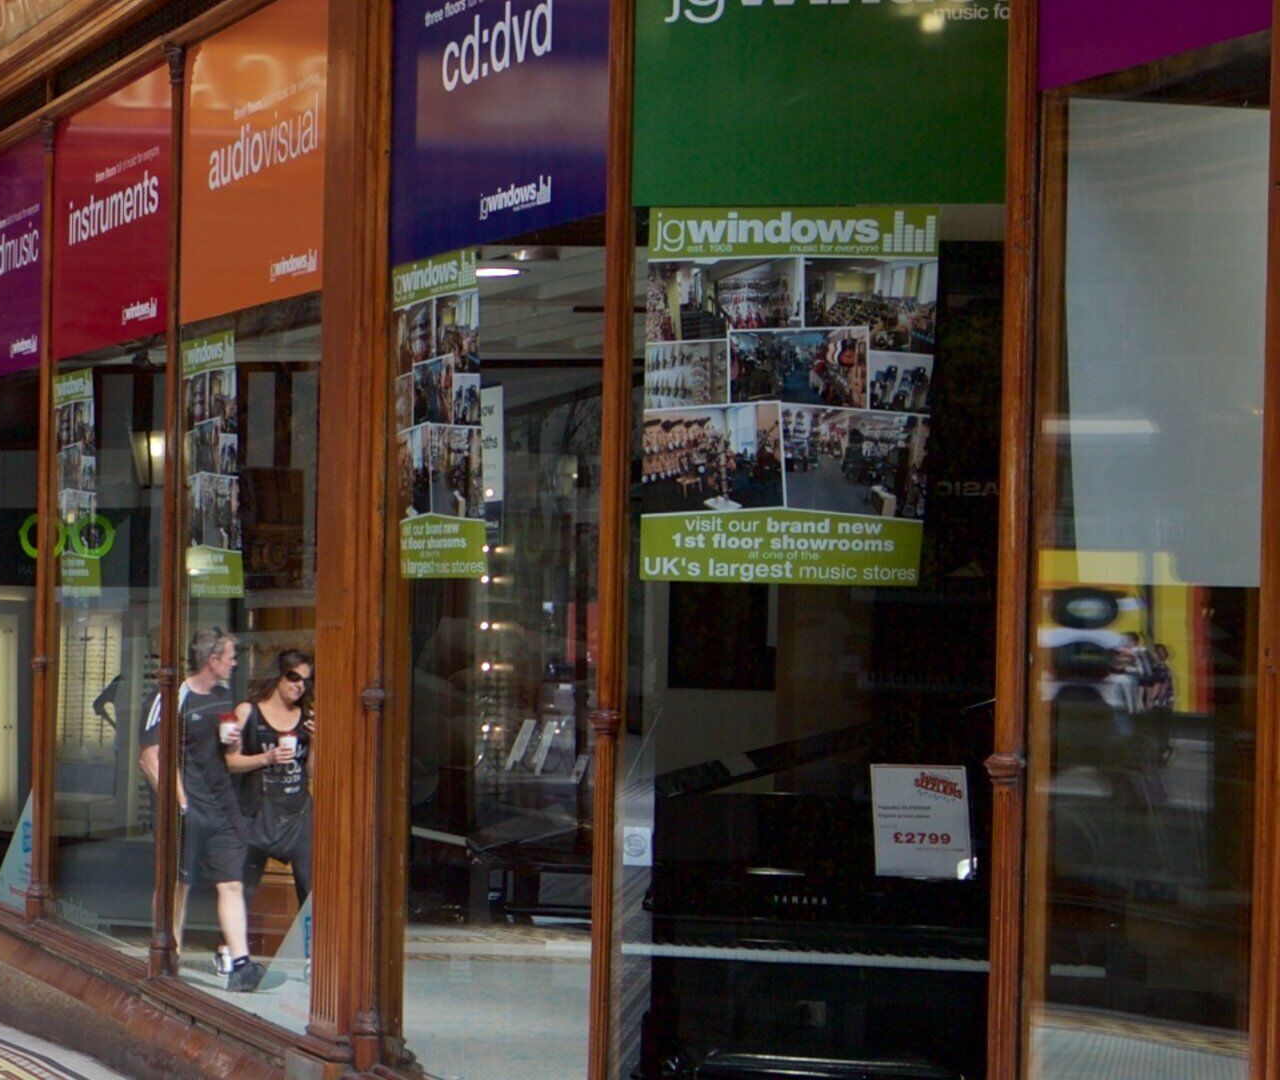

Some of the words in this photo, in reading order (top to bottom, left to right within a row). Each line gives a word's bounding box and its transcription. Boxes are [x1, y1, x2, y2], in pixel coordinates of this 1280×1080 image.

[425, 8, 443, 27] three
[934, 4, 989, 20] music
[993, 4, 1011, 20] fo
[208, 92, 319, 190] audiovisual
[68, 169, 160, 246] instruments
[479, 181, 537, 221] jgwindows
[653, 211, 880, 252] jgwindows
[790, 244, 818, 253] music
[819, 243, 832, 253] for
[834, 244, 880, 254] everyone
[394, 260, 458, 302] gwindows
[685, 516, 722, 532] visit
[728, 519, 760, 533] our
[767, 517, 830, 534] brand
[838, 521, 882, 535] new
[672, 533, 705, 549] 1st
[712, 533, 764, 550] floor
[770, 535, 895, 552] showrooms
[748, 551, 760, 560] at
[762, 552, 784, 560] one
[786, 551, 799, 560] of
[800, 551, 820, 561] the
[451, 560, 485, 573] stores
[643, 557, 701, 577] UK's
[709, 558, 793, 581] largest
[799, 564, 857, 580] music
[863, 565, 916, 581] stores
[893, 831, 952, 845] £2799
[773, 895, 827, 905] YAMAHA
